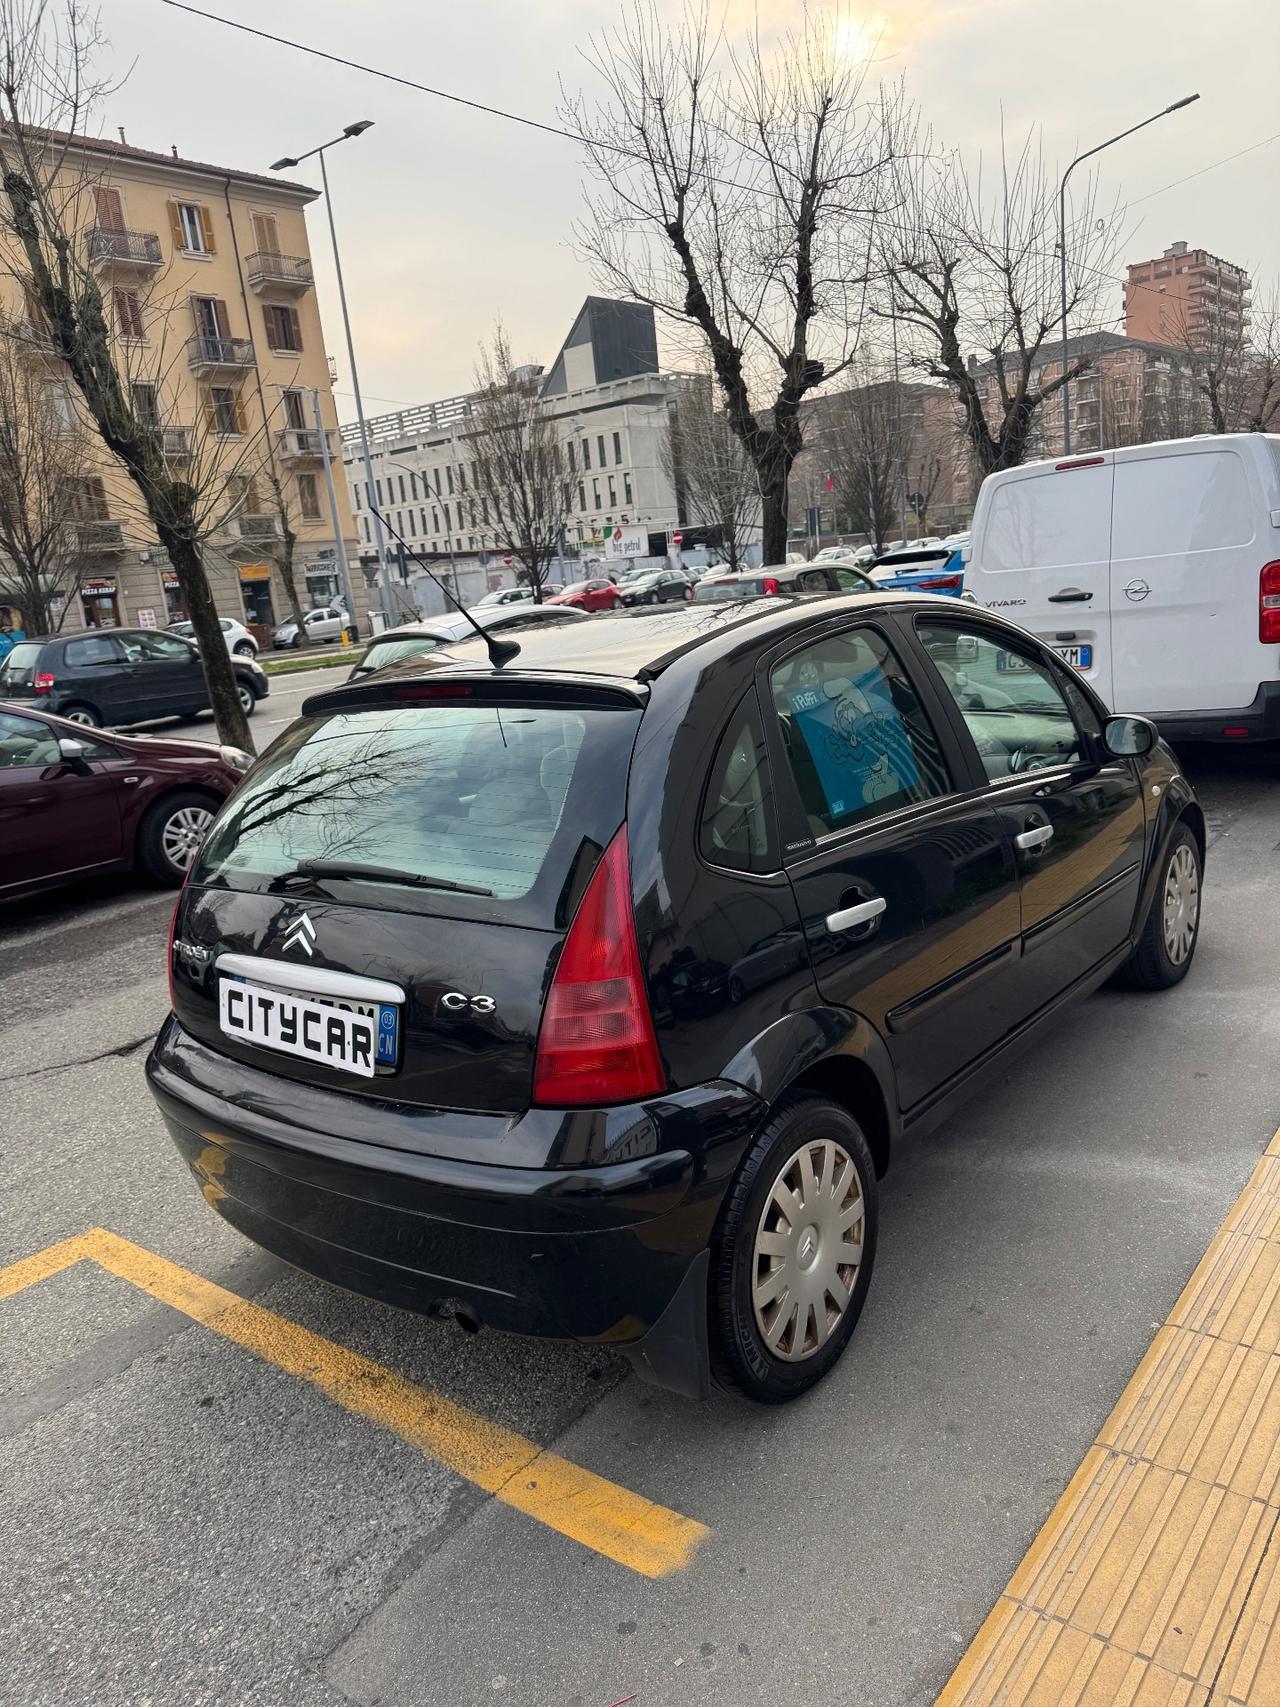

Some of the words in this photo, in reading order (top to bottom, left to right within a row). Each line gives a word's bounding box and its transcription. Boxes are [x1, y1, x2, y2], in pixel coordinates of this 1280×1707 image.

[985, 598, 1026, 608] VIVARO
[441, 992, 496, 1013] C3
[228, 989, 372, 1069] CITYCAR
[379, 1033, 393, 1055] CN
